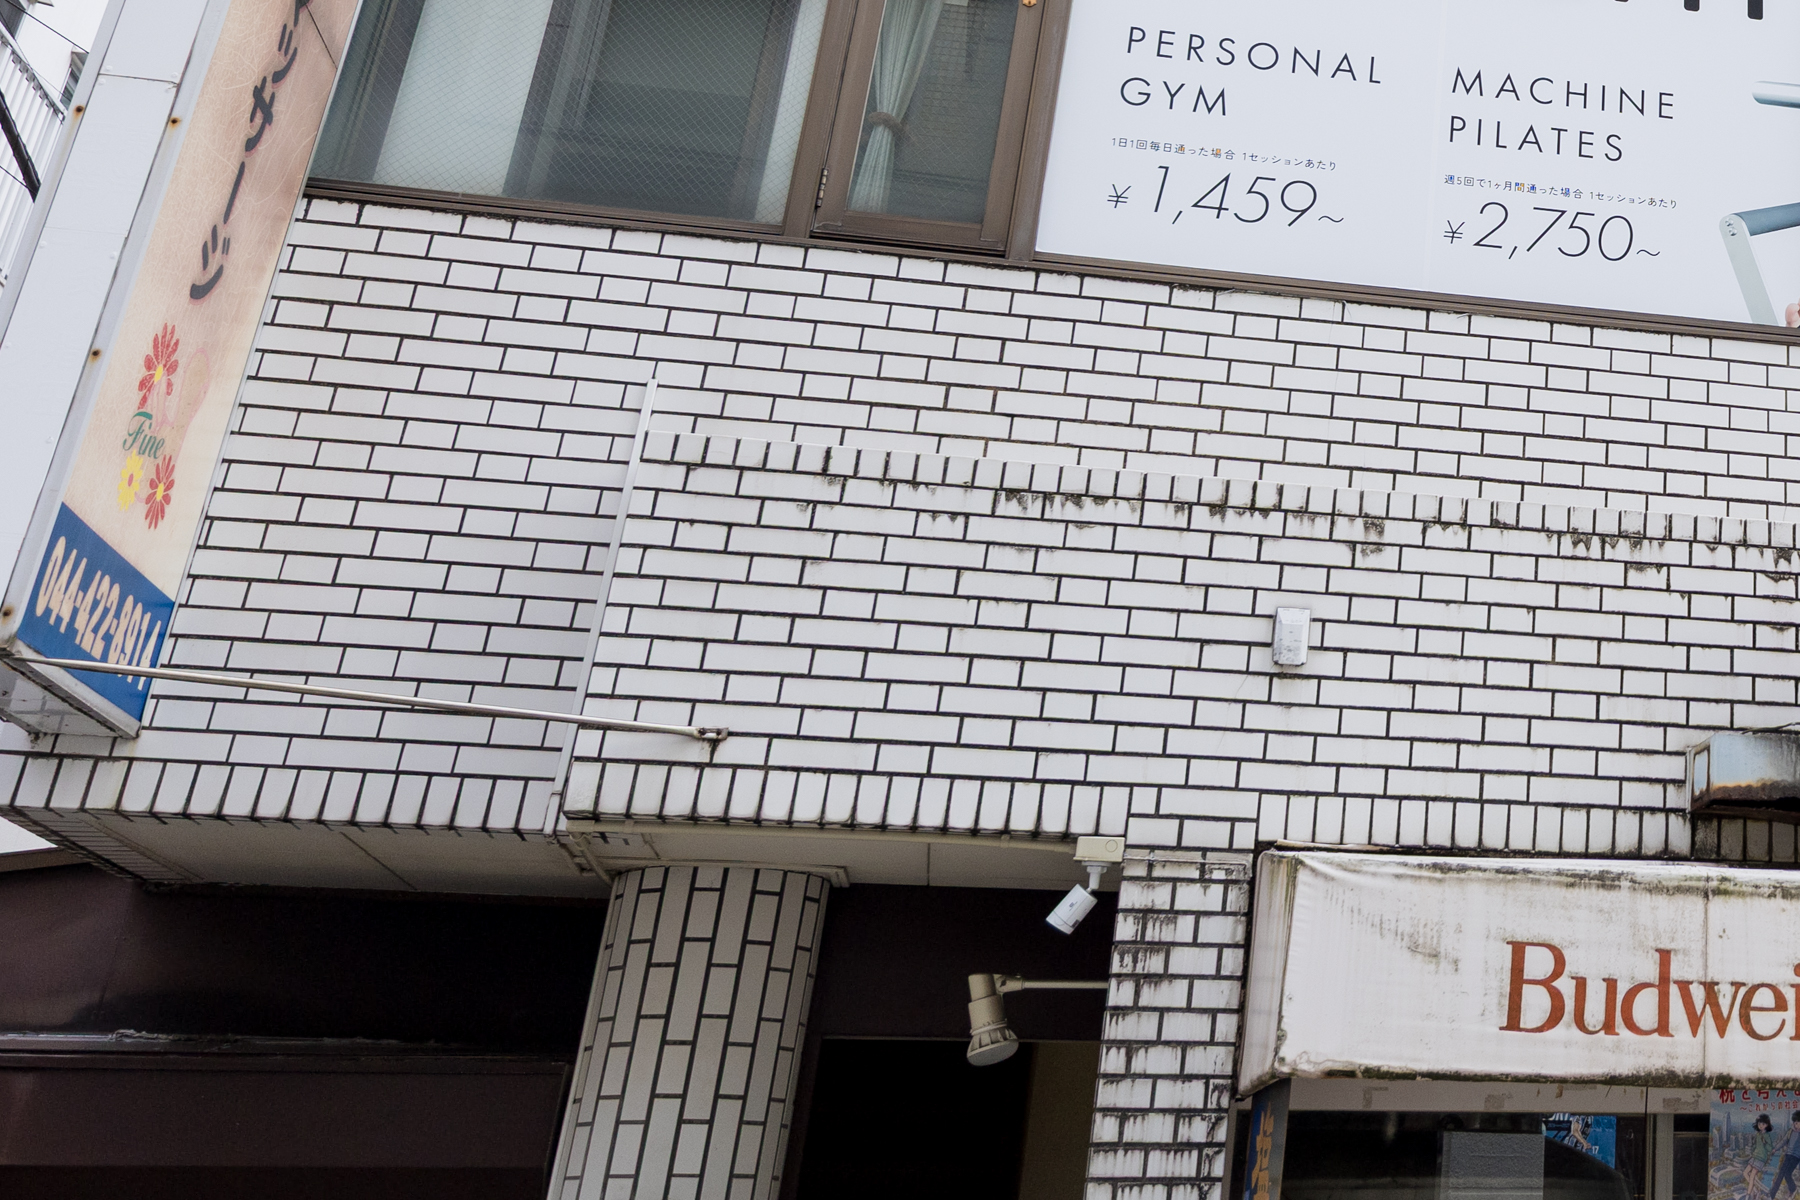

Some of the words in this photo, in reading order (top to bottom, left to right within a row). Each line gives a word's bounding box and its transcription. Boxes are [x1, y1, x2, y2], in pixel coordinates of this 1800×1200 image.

[1126, 26, 1381, 85] PERSONAL
[1119, 77, 1228, 116] GYM
[1452, 67, 1675, 121] MACHINE
[1449, 115, 1624, 162] PILATES
[122, 411, 165, 461] Fine
[36, 535, 162, 691] 044-422-8914
